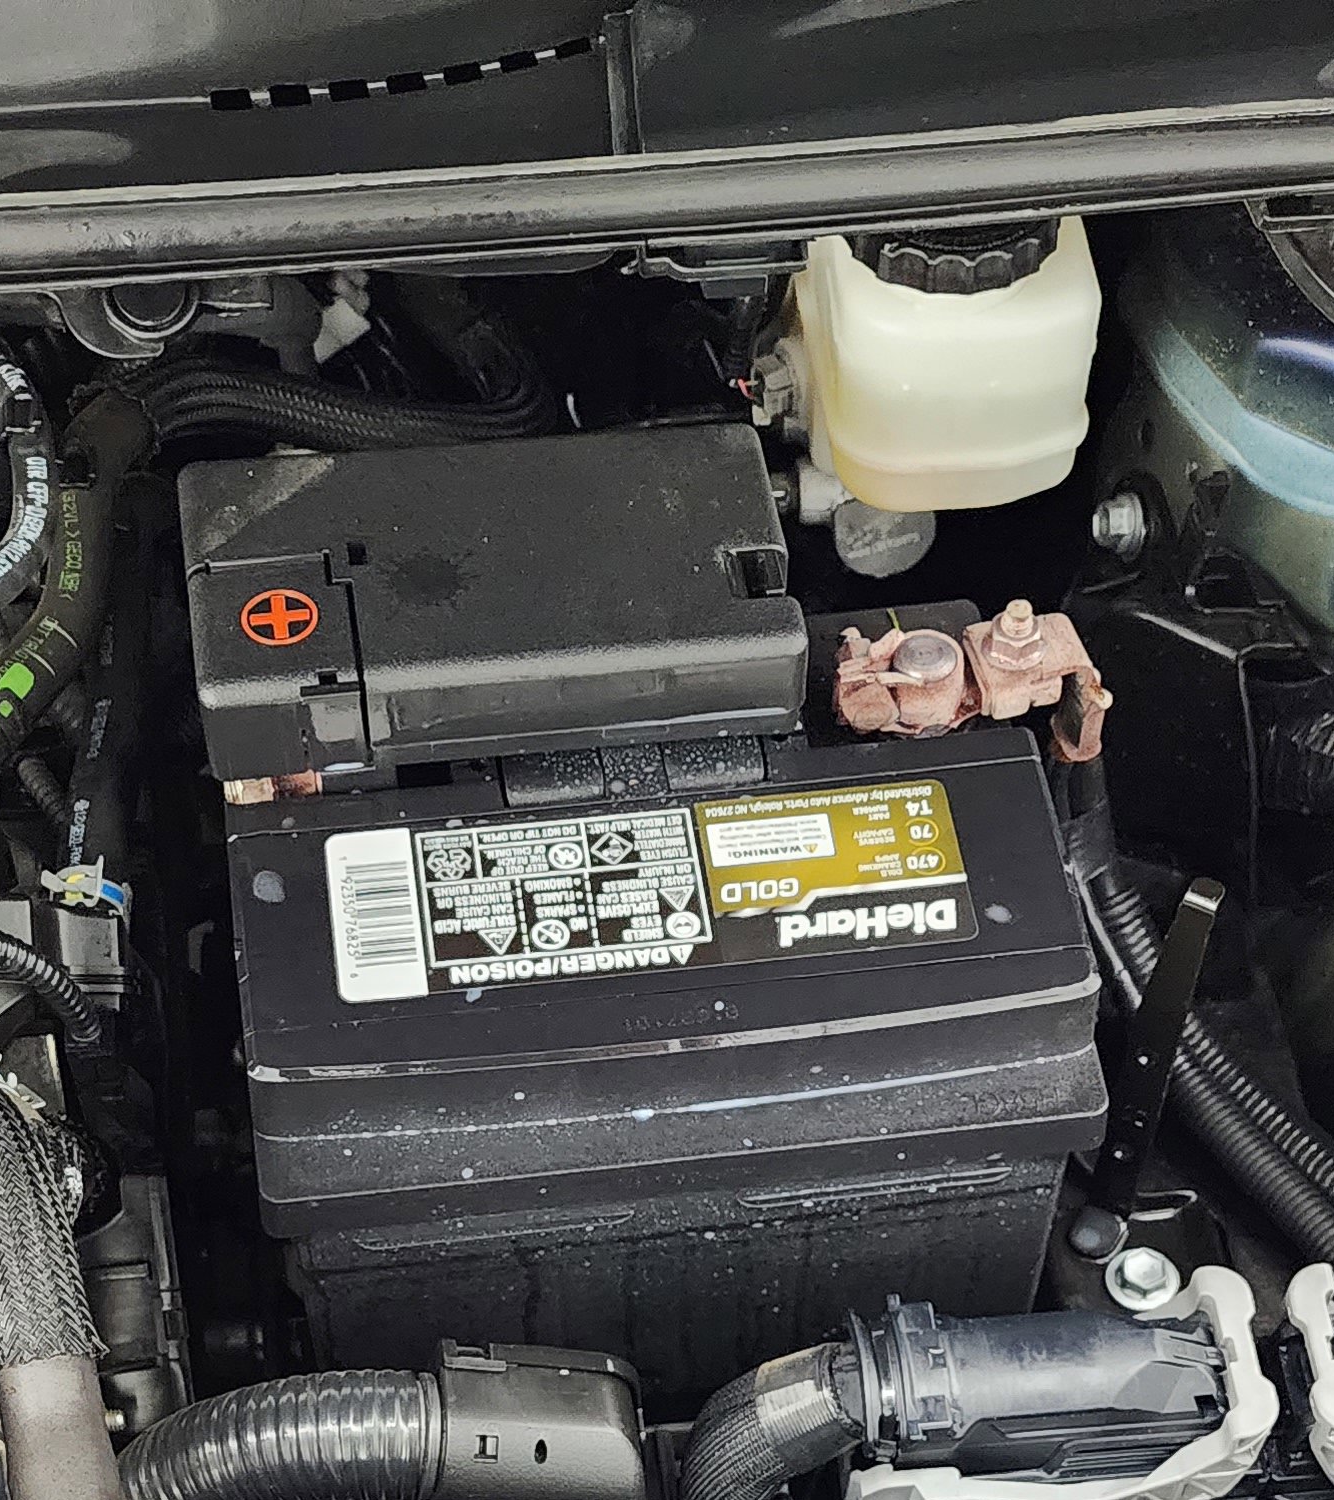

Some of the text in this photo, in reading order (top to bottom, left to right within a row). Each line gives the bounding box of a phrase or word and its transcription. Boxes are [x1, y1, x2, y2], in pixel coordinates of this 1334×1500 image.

[831, 791, 868, 804] Advance
[884, 785, 932, 800] Distributed
[809, 795, 830, 807] Auto
[905, 799, 932, 816] T4
[734, 804, 747, 814] NC
[509, 830, 524, 840] OR
[525, 829, 540, 838] TIP
[541, 827, 561, 837] NOT
[562, 826, 576, 835] DO
[909, 823, 932, 839] 70
[530, 844, 544, 854] OF
[639, 849, 660, 860] EYES
[727, 844, 800, 859] WARNING:
[496, 853, 546, 866] THE REACH
[906, 853, 939, 870] 470
[506, 864, 523, 874] OUT
[637, 863, 691, 877] OR INJURY
[432, 880, 510, 897] SEVERE BURNS
[524, 876, 572, 891] SMOKING
[601, 873, 693, 892] CAUSE BLINDNESS
[719, 876, 800, 903] GOLD
[340, 876, 355, 915] 92350
[436, 891, 512, 908] BLINDNESS OR
[532, 889, 575, 904] FLAMES
[595, 888, 657, 904] GASES CAN
[454, 902, 513, 917] CAN CAUSE
[535, 903, 576, 918] SPARKS
[596, 900, 659, 918] EXPLOSIVE
[434, 913, 515, 933] SULFURIC ACID
[568, 916, 588, 931] NO
[630, 914, 662, 927] EYES
[775, 897, 958, 948] DieHard
[345, 919, 359, 957] 76825
[622, 926, 664, 941] SHIELD
[448, 946, 670, 983] DANGER/POISON
